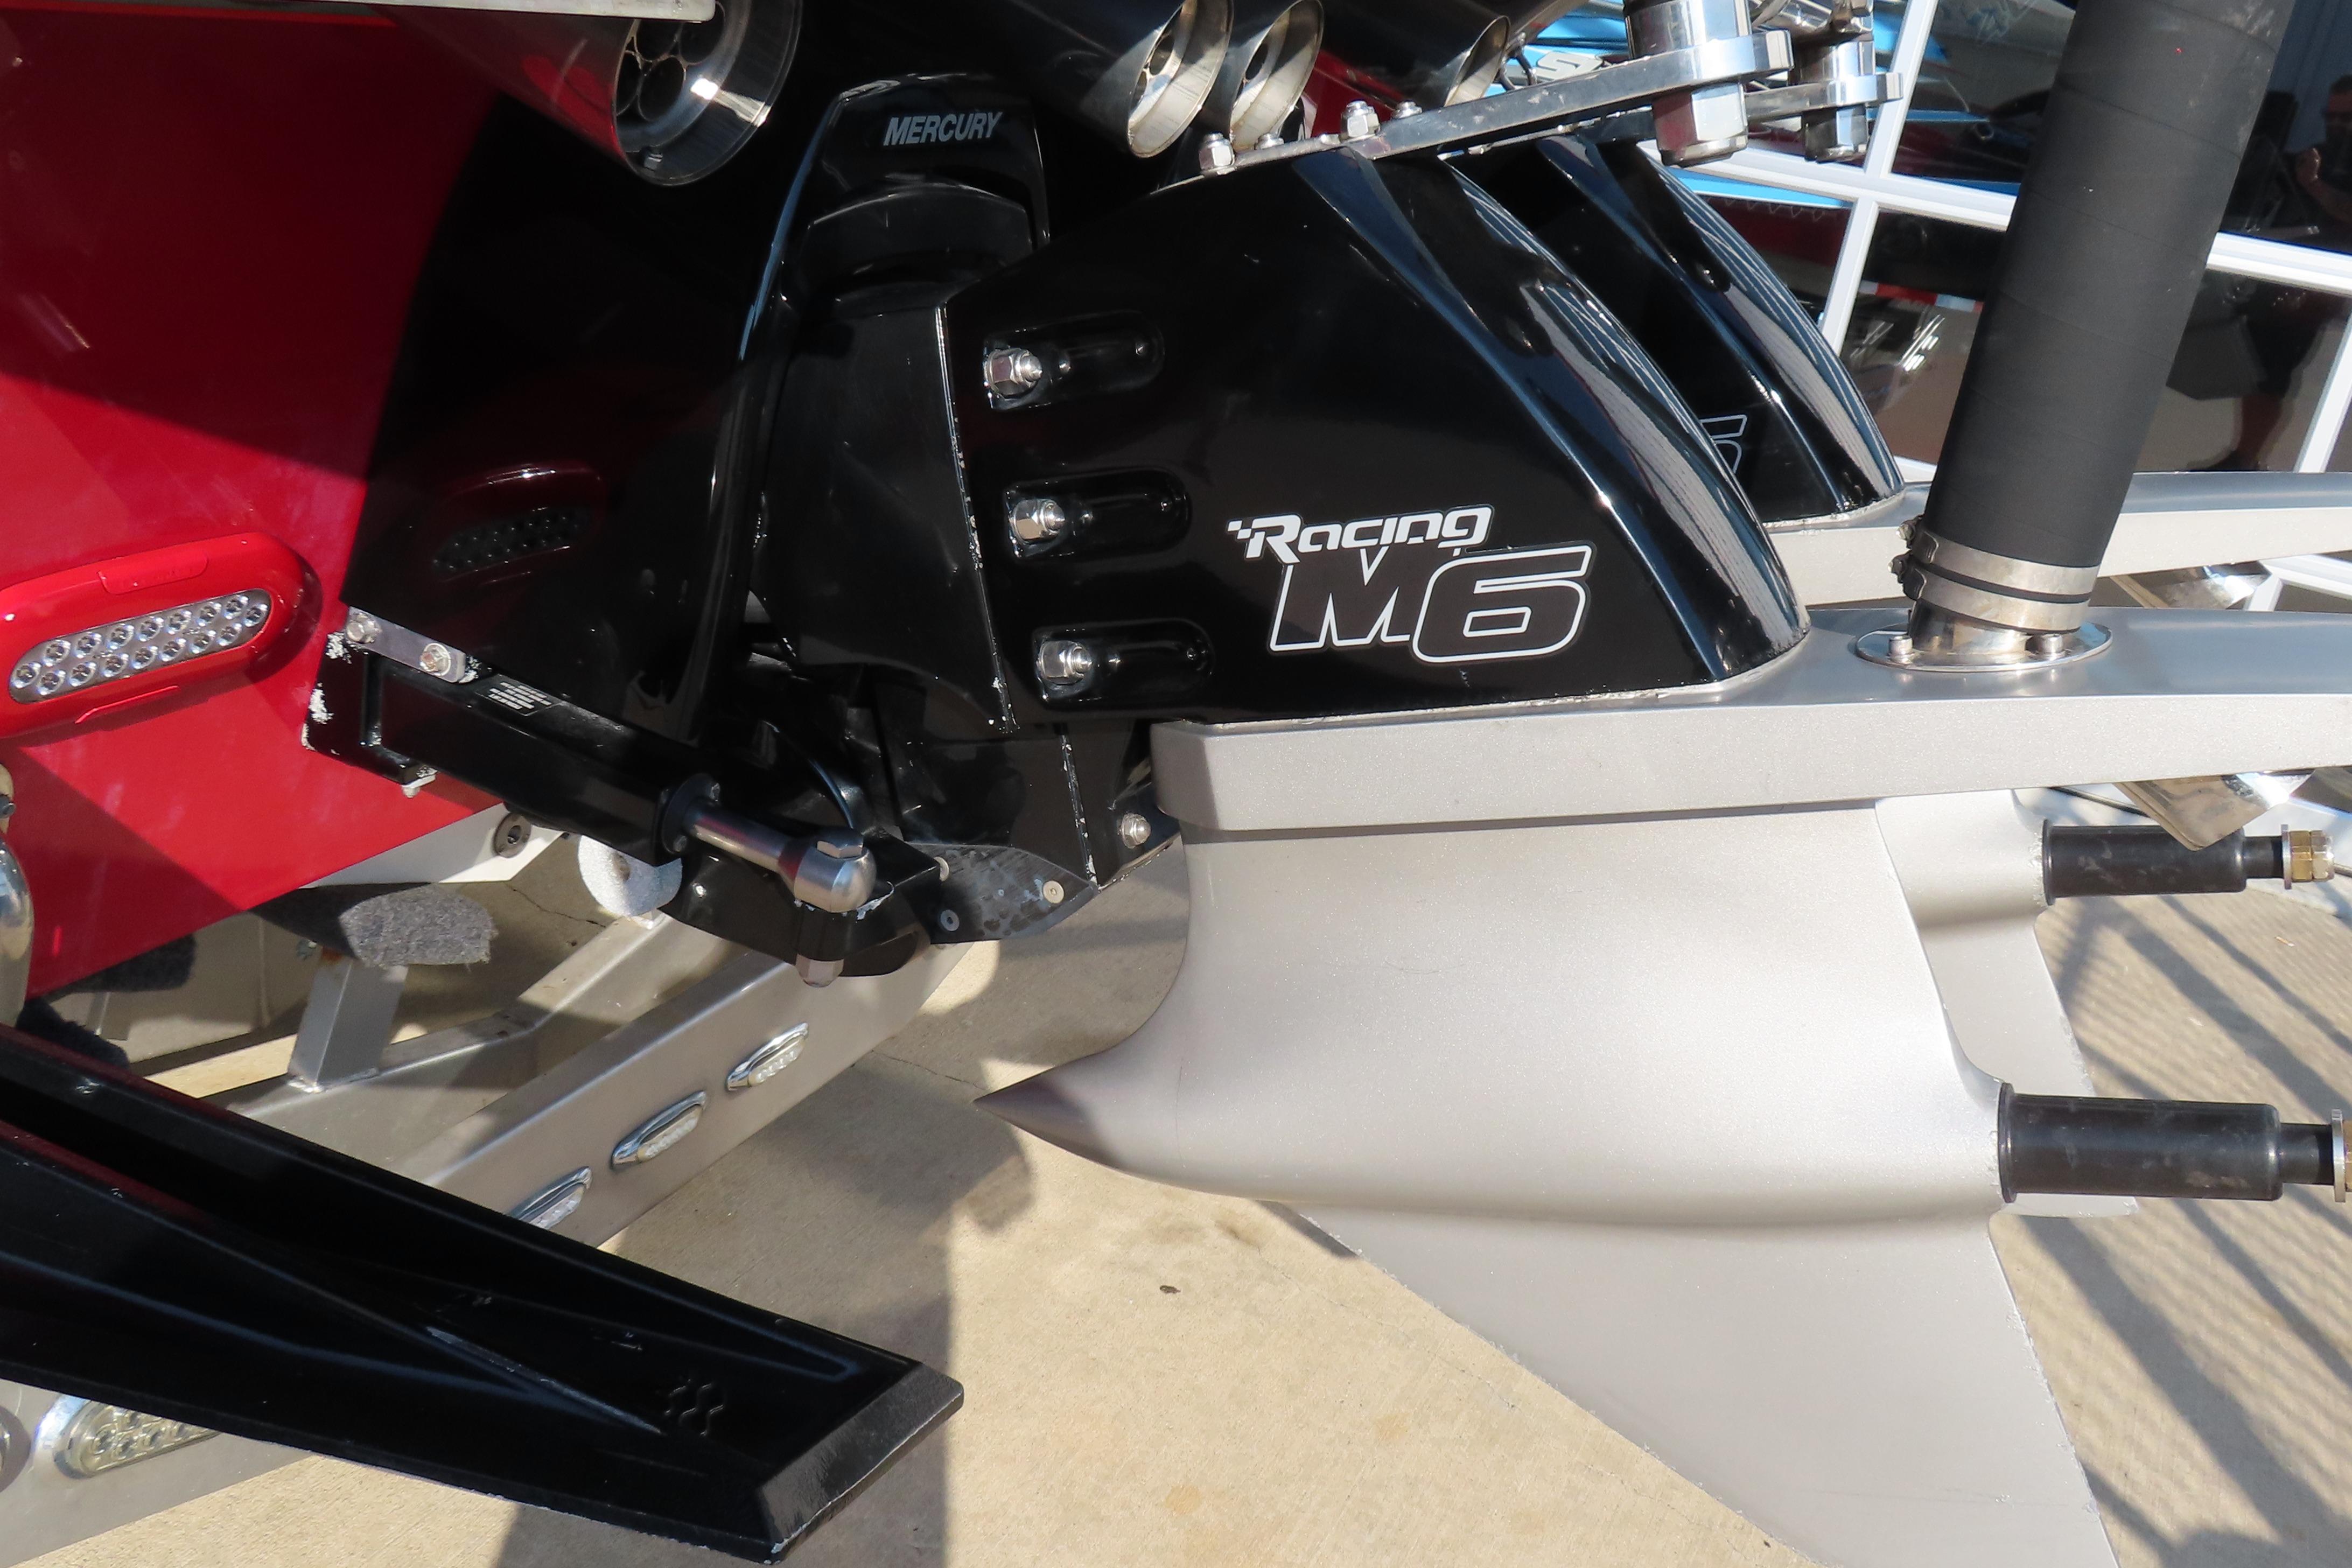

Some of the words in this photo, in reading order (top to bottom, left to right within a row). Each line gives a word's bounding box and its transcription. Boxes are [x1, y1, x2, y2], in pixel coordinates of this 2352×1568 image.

[883, 111, 1003, 146] MERCURY
[1238, 504, 1493, 565] Racing
[1269, 544, 1593, 663] M6
